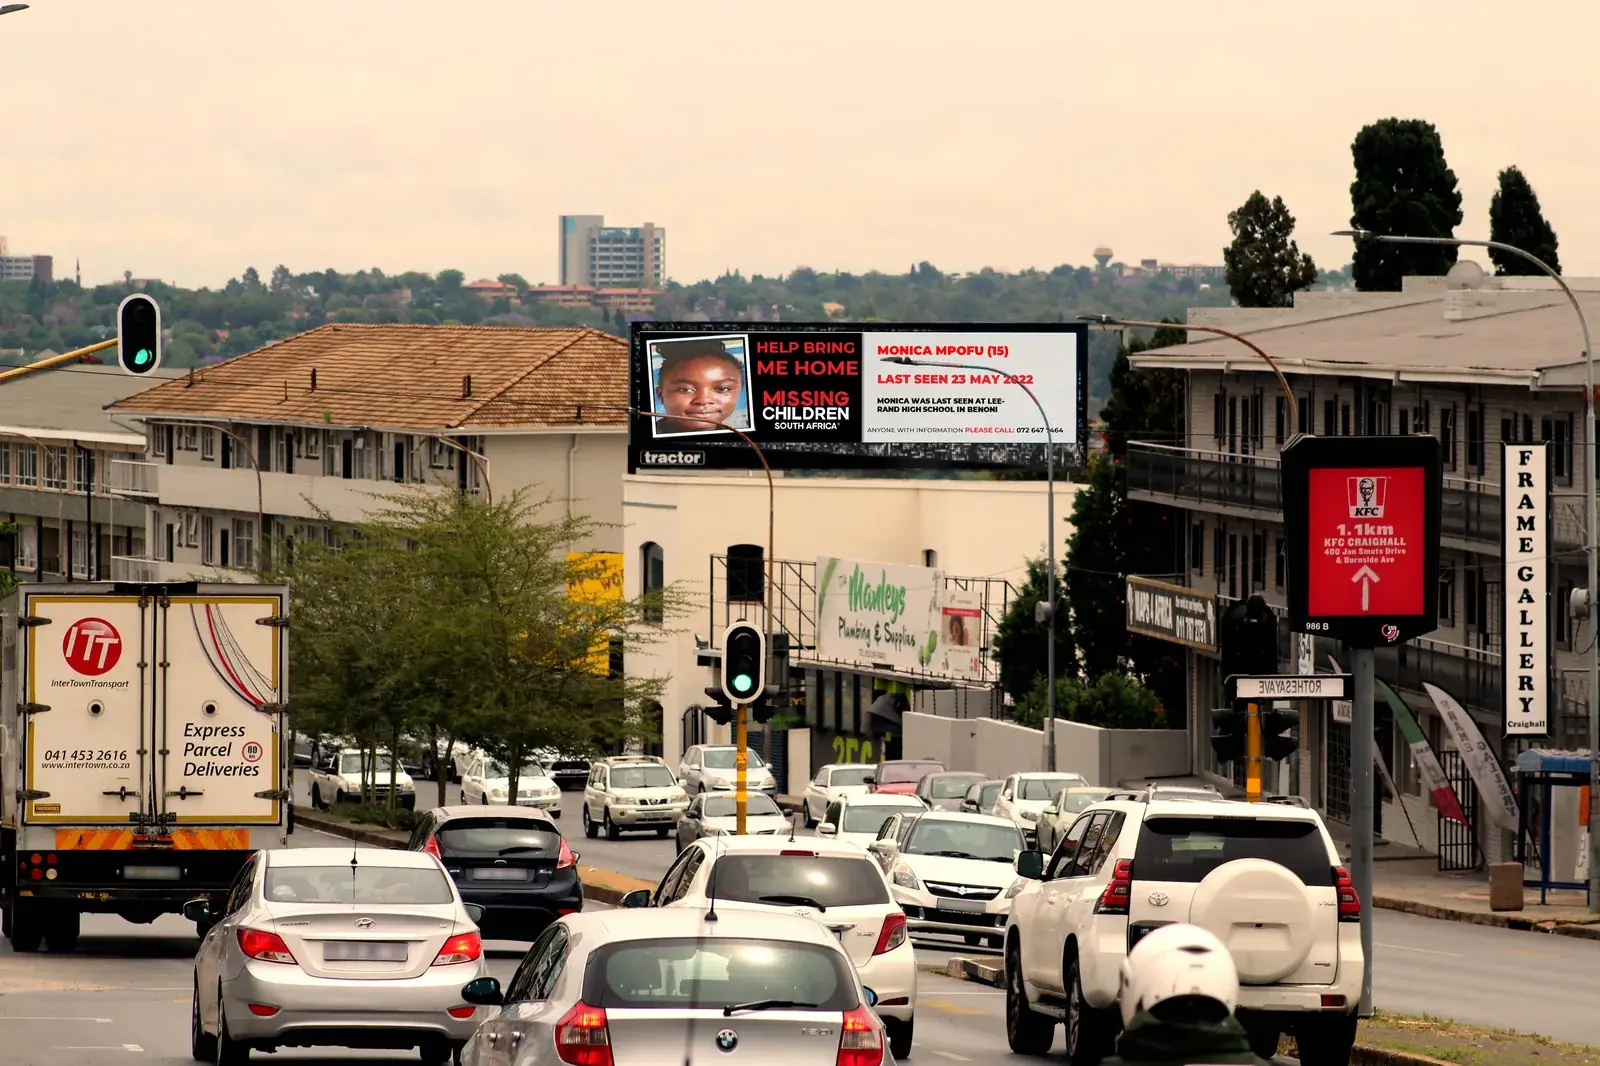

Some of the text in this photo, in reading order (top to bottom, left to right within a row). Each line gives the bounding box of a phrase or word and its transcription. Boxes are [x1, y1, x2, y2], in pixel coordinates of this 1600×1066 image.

[757, 342, 855, 354] HELP BRING
[877, 345, 1009, 358] MONICA MPOFU (15)
[757, 361, 859, 375] ME HOME
[877, 375, 1034, 384] LAST SEEN 23 MAY 2022
[763, 391, 849, 406] MISSING
[877, 397, 1005, 405] MONICA WAS LAST SEEN AT LEE-
[762, 407, 849, 420] CHILDREN
[774, 422, 838, 430] SOUTH AFRICA
[644, 452, 701, 464] tractor
[1354, 507, 1379, 516] KFC
[1336, 523, 1394, 536] 1.1km
[1324, 537, 1406, 547] KFC CRAIGHALL
[1516, 450, 1535, 713] FRAME GALLERY
[848, 563, 906, 624] Manleys
[1306, 622, 1329, 630] 986 B
[838, 615, 871, 648] Plumbing
[884, 622, 916, 652] Supplies
[65, 626, 119, 669] ITT
[51, 679, 129, 689] InterTownTransport
[1507, 720, 1546, 728] Craighall
[184, 723, 245, 740] Express
[44, 750, 127, 761] 041 453 2616
[184, 742, 232, 757] Parcel
[247, 745, 258, 754] 80
[41, 761, 130, 770] www.intertown.co.za
[184, 762, 259, 777] Deliveries
